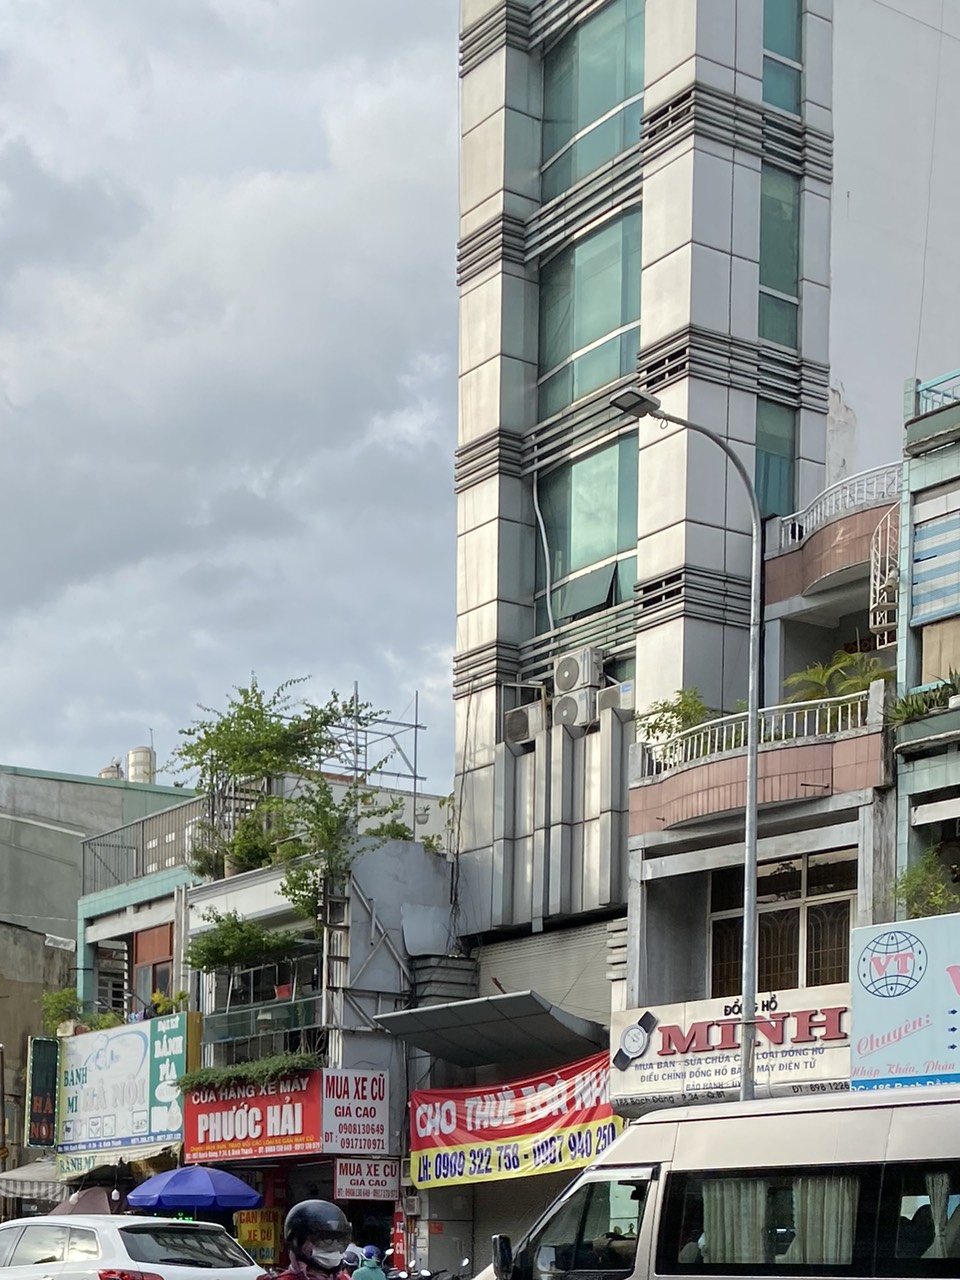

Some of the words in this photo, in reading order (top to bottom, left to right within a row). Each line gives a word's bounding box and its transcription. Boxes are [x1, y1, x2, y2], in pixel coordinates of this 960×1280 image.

[871, 952, 915, 977] VT
[657, 1006, 848, 1057] MINH
[64, 1065, 88, 1087] BÁNH
[259, 1080, 277, 1096] XE
[325, 1075, 350, 1100] MUA
[353, 1076, 368, 1101] XE
[370, 1073, 386, 1102] CŨ
[197, 1101, 262, 1144] PHƯỚC
[266, 1095, 303, 1138] HẢI
[334, 1104, 352, 1118] GIÁ
[355, 1106, 377, 1119] CAO
[415, 1100, 457, 1138] CHO
[465, 1085, 516, 1131] THUÊ
[338, 1123, 385, 1135] 0908130649
[340, 1138, 386, 1150] 0917170971
[418, 1155, 431, 1182] LH:
[469, 1147, 492, 1175] 322
[496, 1142, 520, 1172] 758
[568, 1129, 592, 1160] 940
[595, 1122, 616, 1155] 250
[339, 1163, 362, 1176] MUA
[366, 1163, 380, 1177] XE
[383, 1161, 397, 1177] CŨ
[349, 1178, 366, 1187] GIÁ
[368, 1179, 387, 1187] CAO
